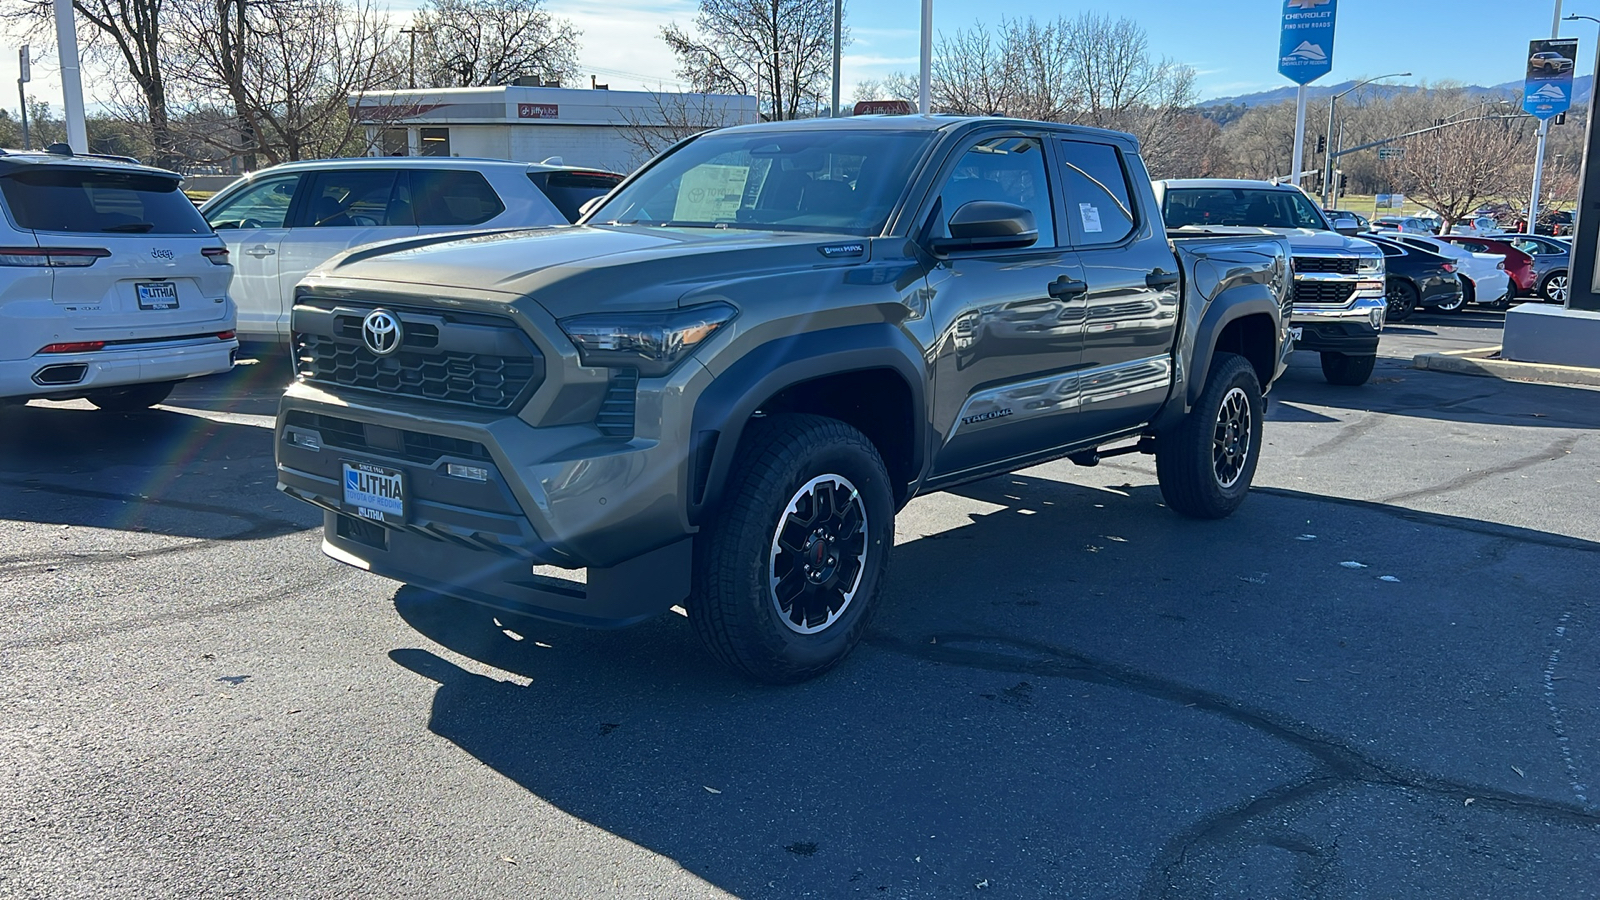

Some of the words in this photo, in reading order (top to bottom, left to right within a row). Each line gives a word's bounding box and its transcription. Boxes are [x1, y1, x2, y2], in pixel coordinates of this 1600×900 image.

[1285, 11, 1331, 19] CHEVROLET
[151, 248, 175, 260] Jeep
[148, 287, 175, 298] LITHIA
[962, 408, 1014, 424] TACOMA
[359, 464, 373, 472] SINCE
[359, 473, 403, 501] LITHIA
[347, 490, 367, 501] TOYOTA
[368, 494, 375, 503] OF
[364, 508, 385, 522] LITHIA
